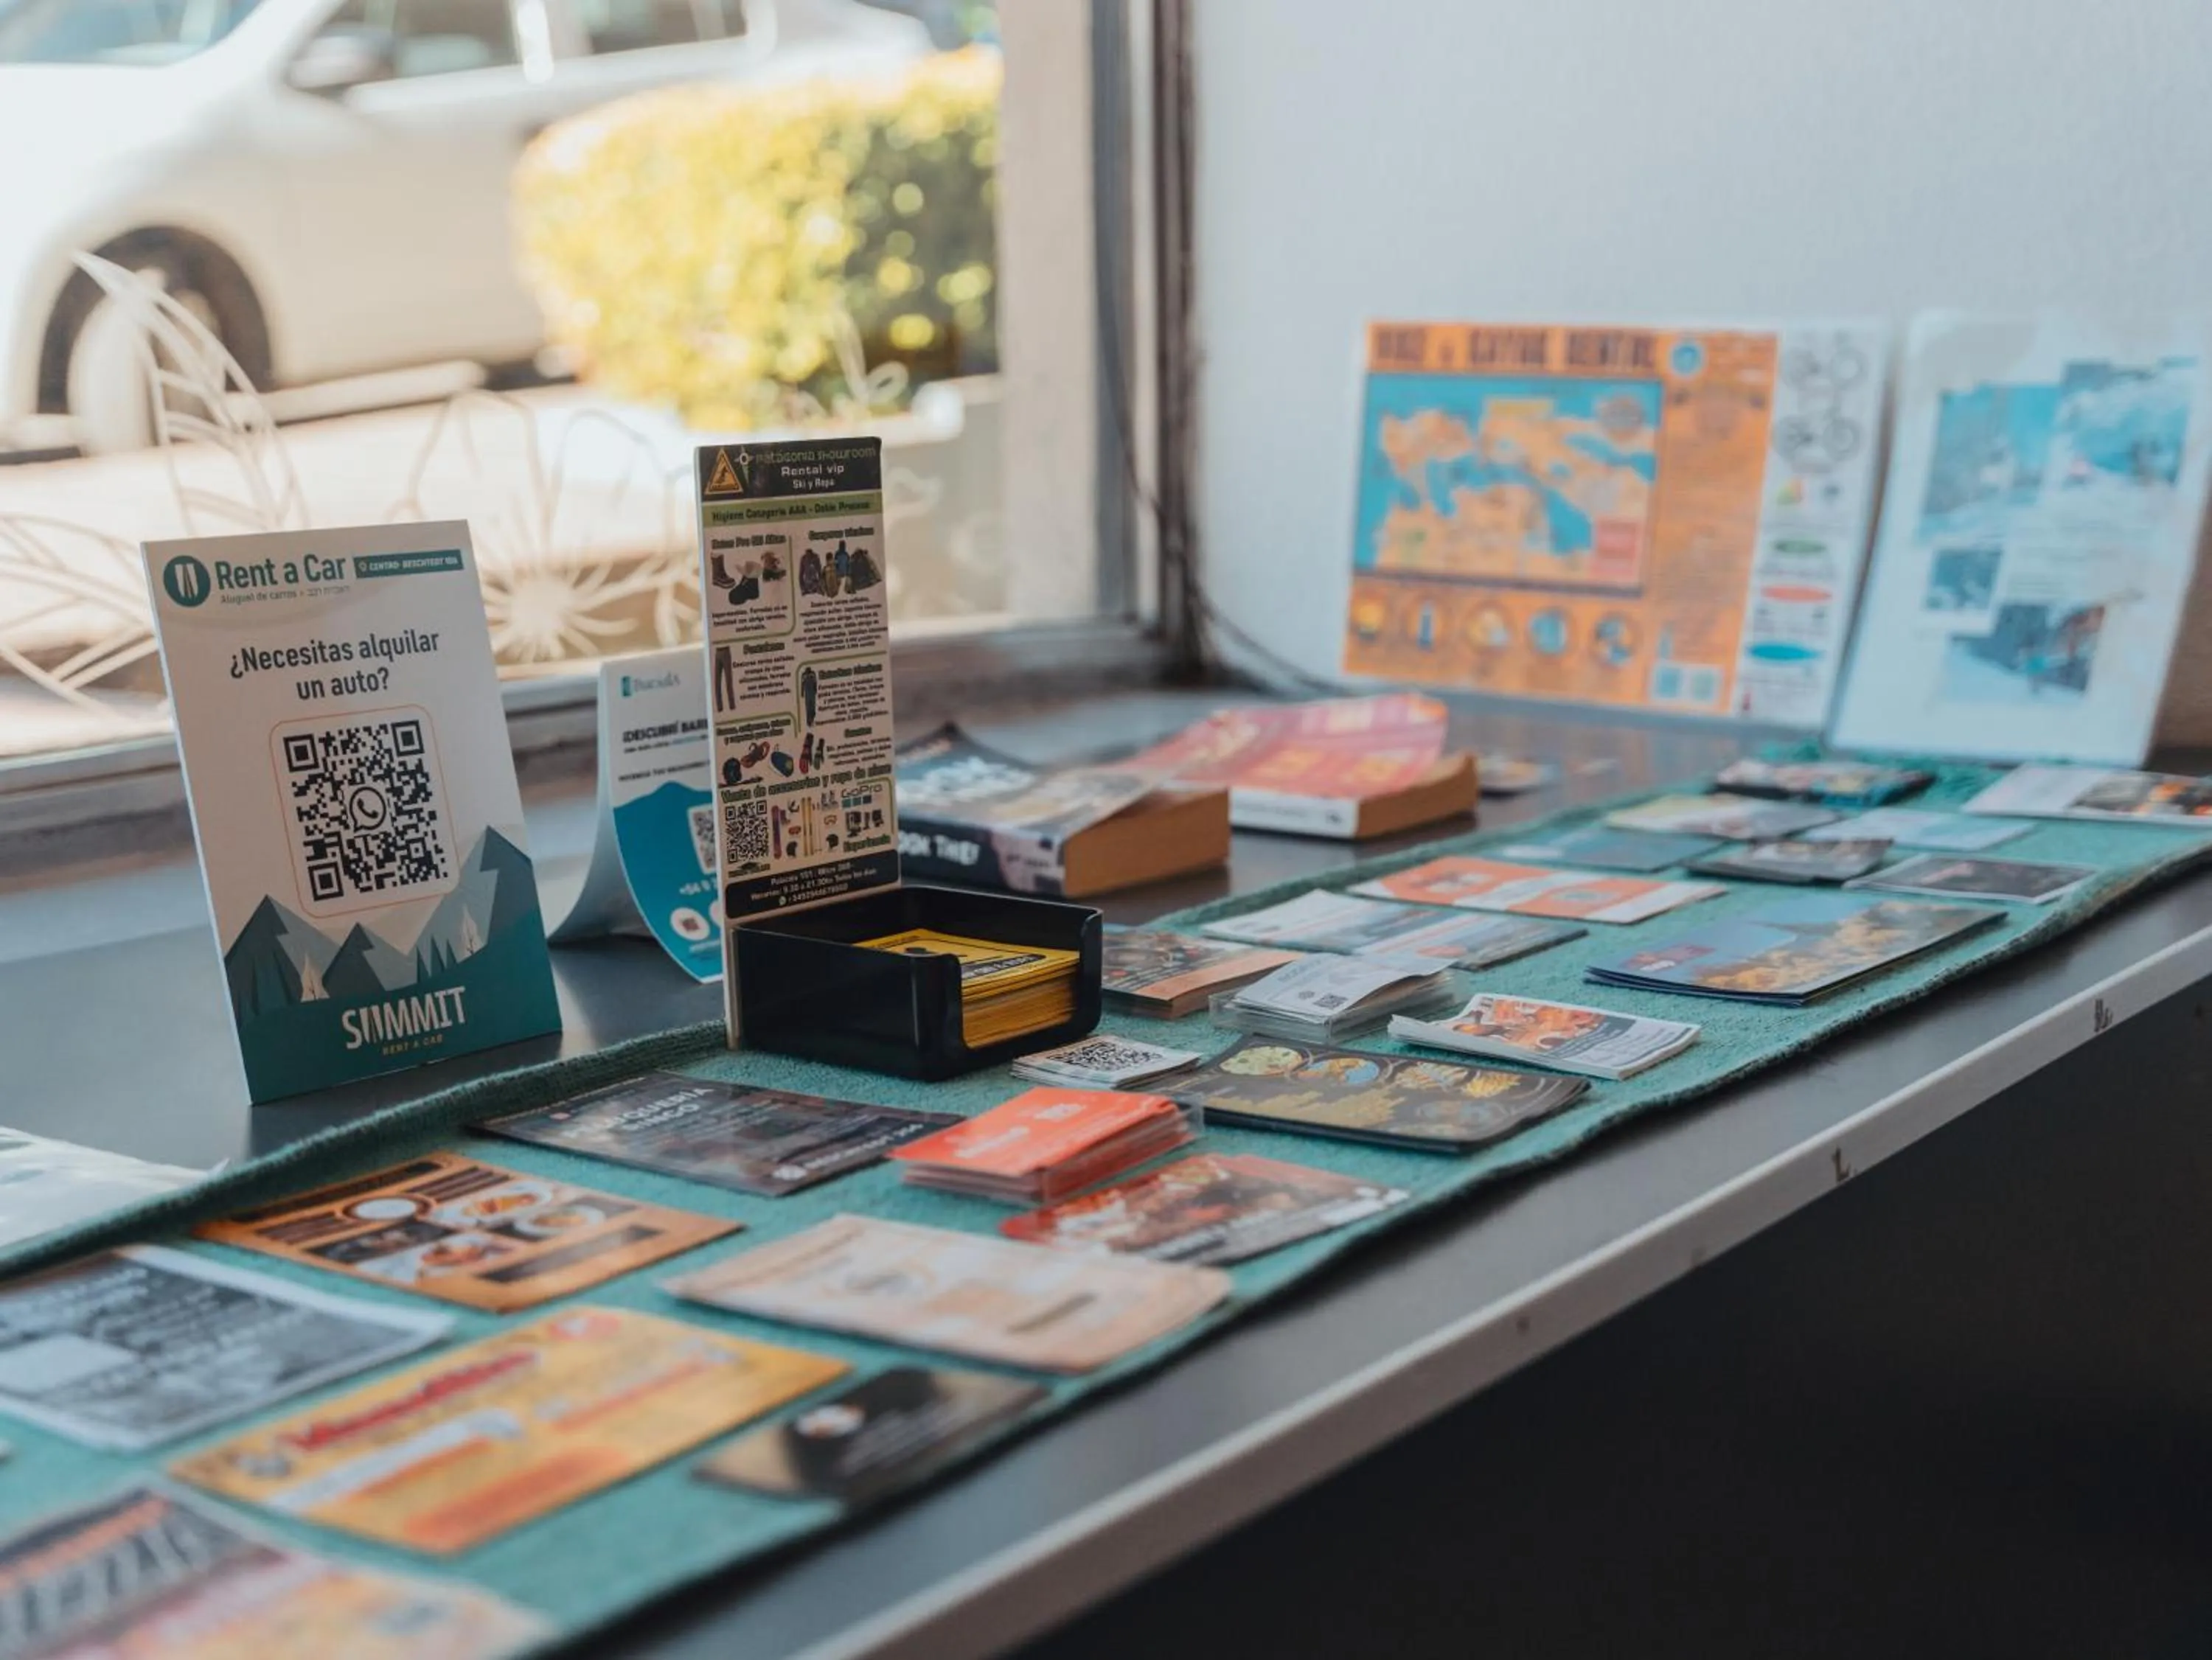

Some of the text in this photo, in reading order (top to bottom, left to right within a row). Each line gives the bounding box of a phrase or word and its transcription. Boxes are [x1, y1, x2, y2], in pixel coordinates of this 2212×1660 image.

[781, 463, 844, 477] Rental vip
[214, 553, 347, 590] Rent a Car
[256, 591, 268, 601] de
[230, 629, 439, 679] ¿Necesitas alquilar
[296, 666, 390, 700] un auto?
[840, 784, 883, 798] GoPro
[341, 985, 466, 1050] SUMMIT
[382, 1033, 443, 1056] RENT A CAR
